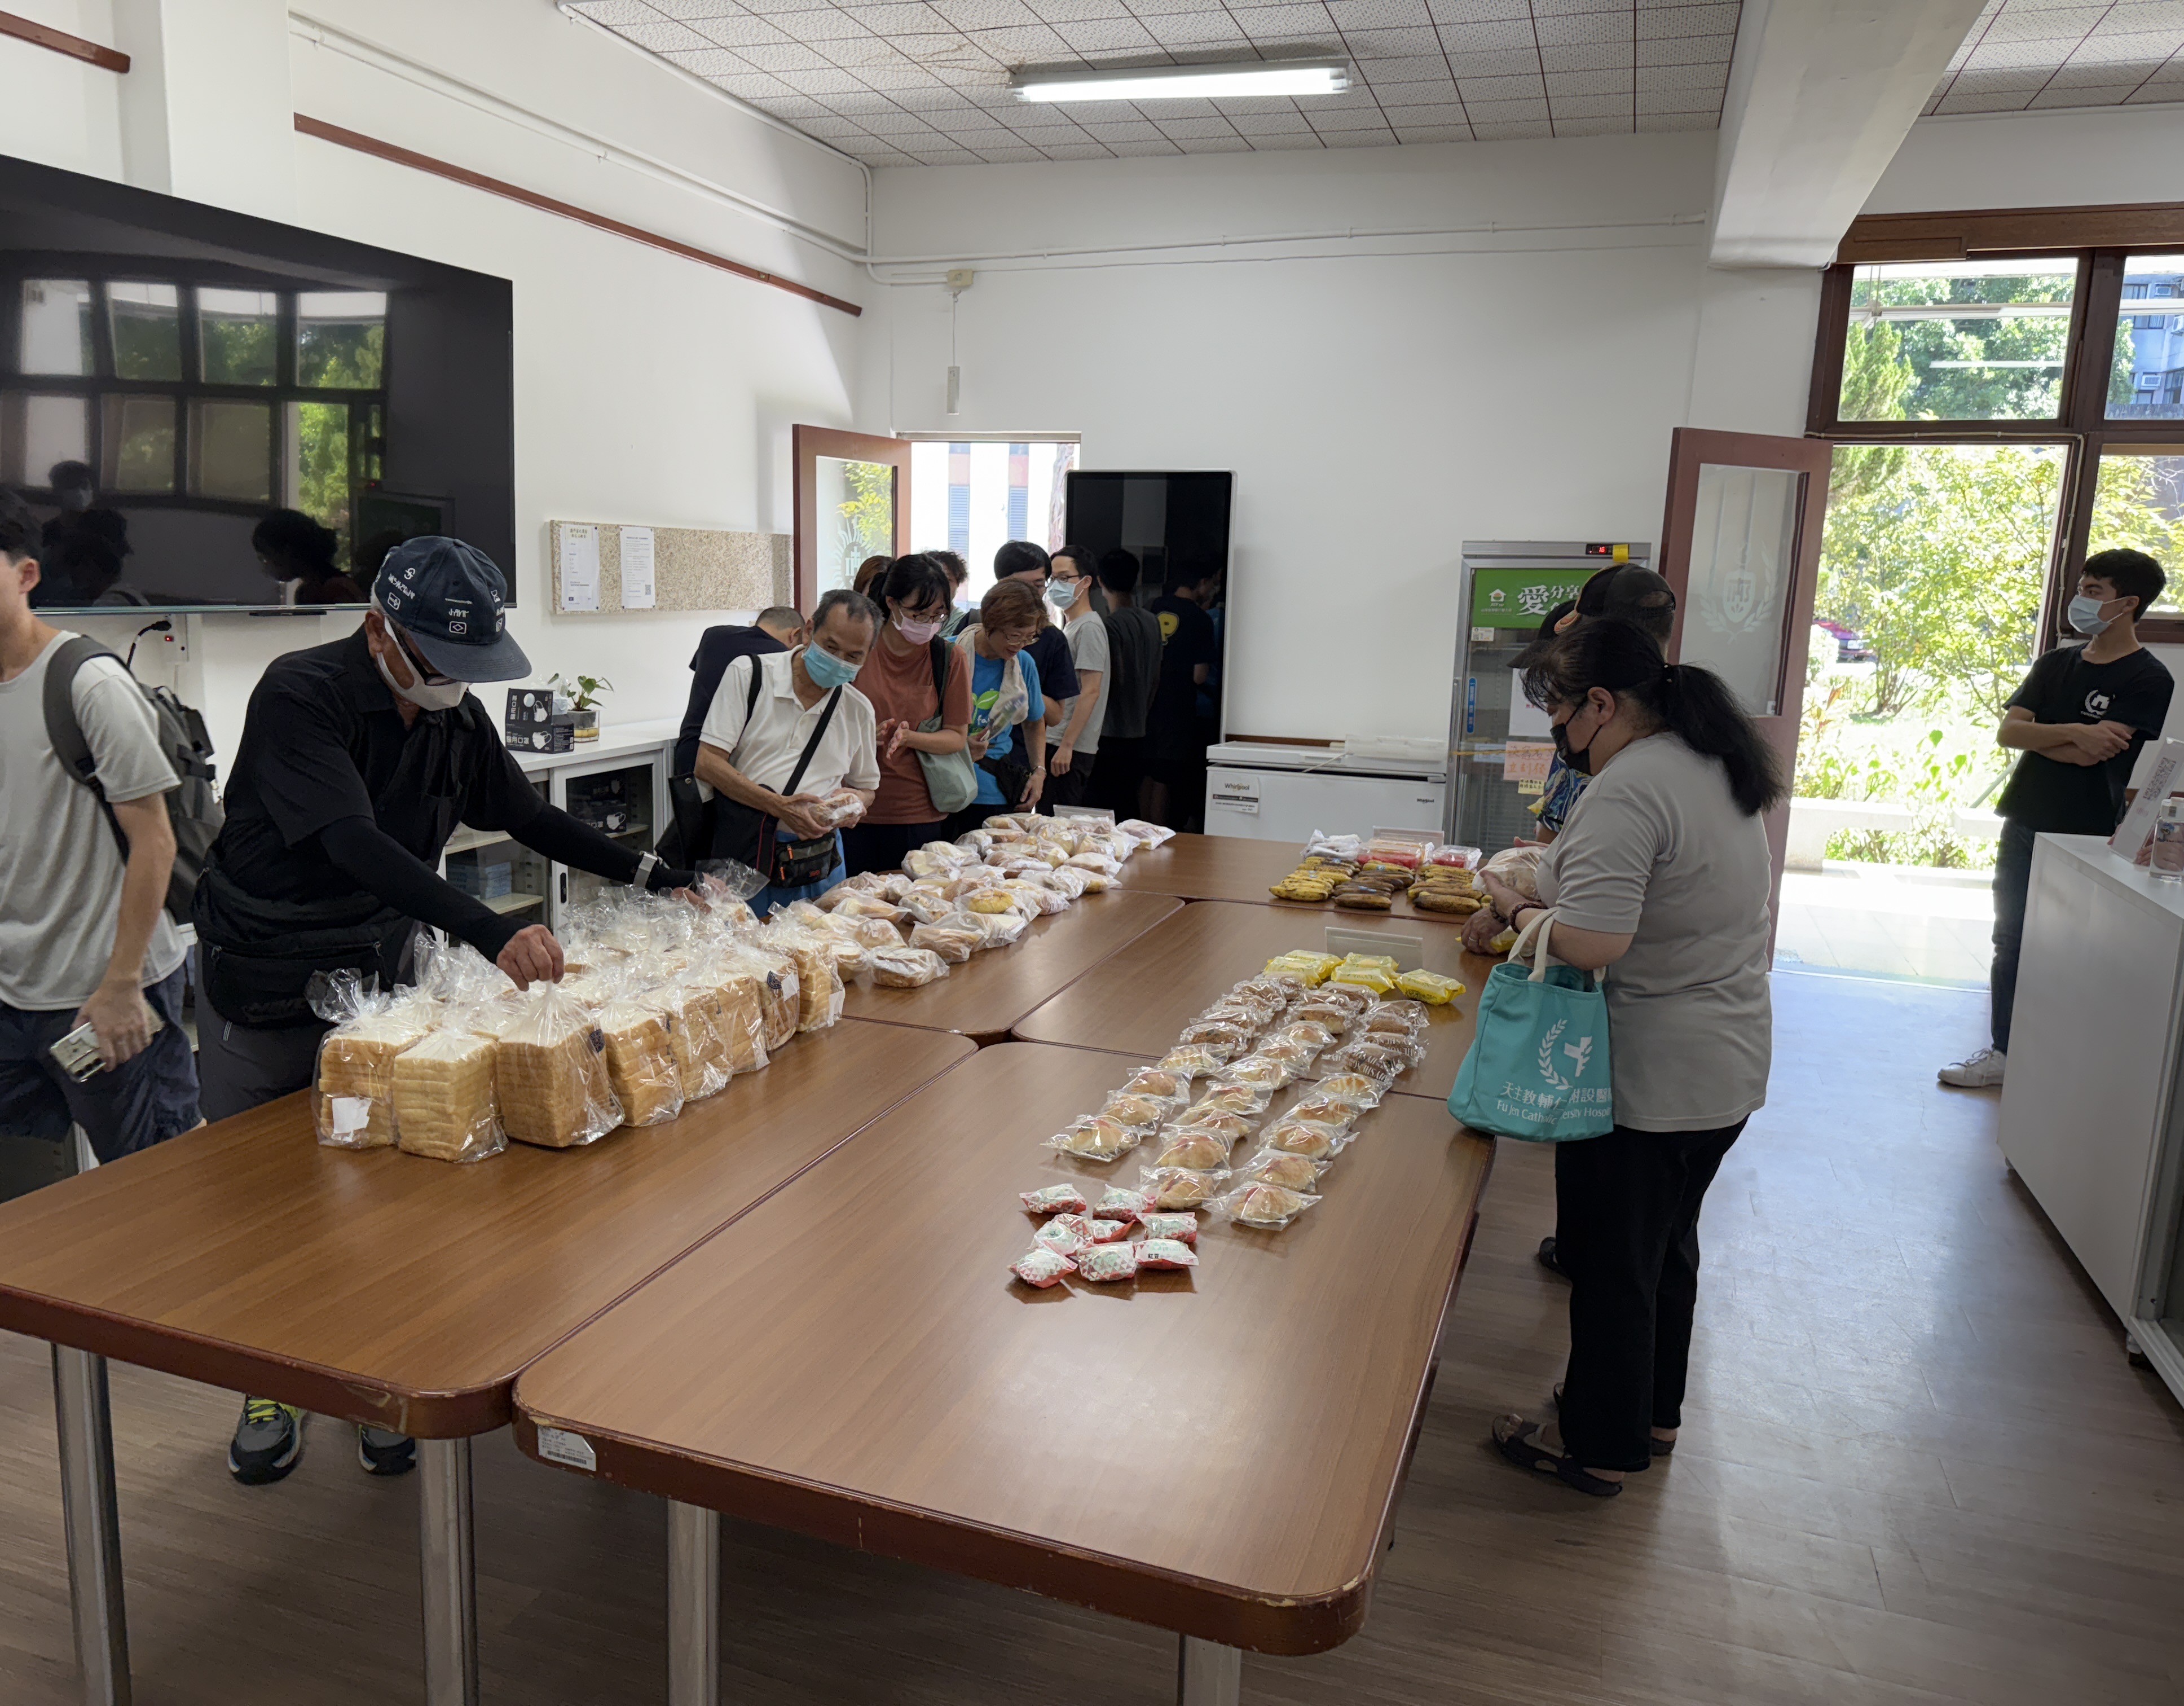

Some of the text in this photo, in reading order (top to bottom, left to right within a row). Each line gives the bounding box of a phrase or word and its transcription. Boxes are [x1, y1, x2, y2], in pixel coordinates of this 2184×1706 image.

[1516, 584, 1549, 615] 愛
[1225, 782, 1250, 791] Whirlpool
[1496, 1100, 1508, 1113] Fu
[1508, 1104, 1520, 1116] Jen
[1521, 1109, 1557, 1125] Catholic
[1562, 1110, 1582, 1120] ersity
